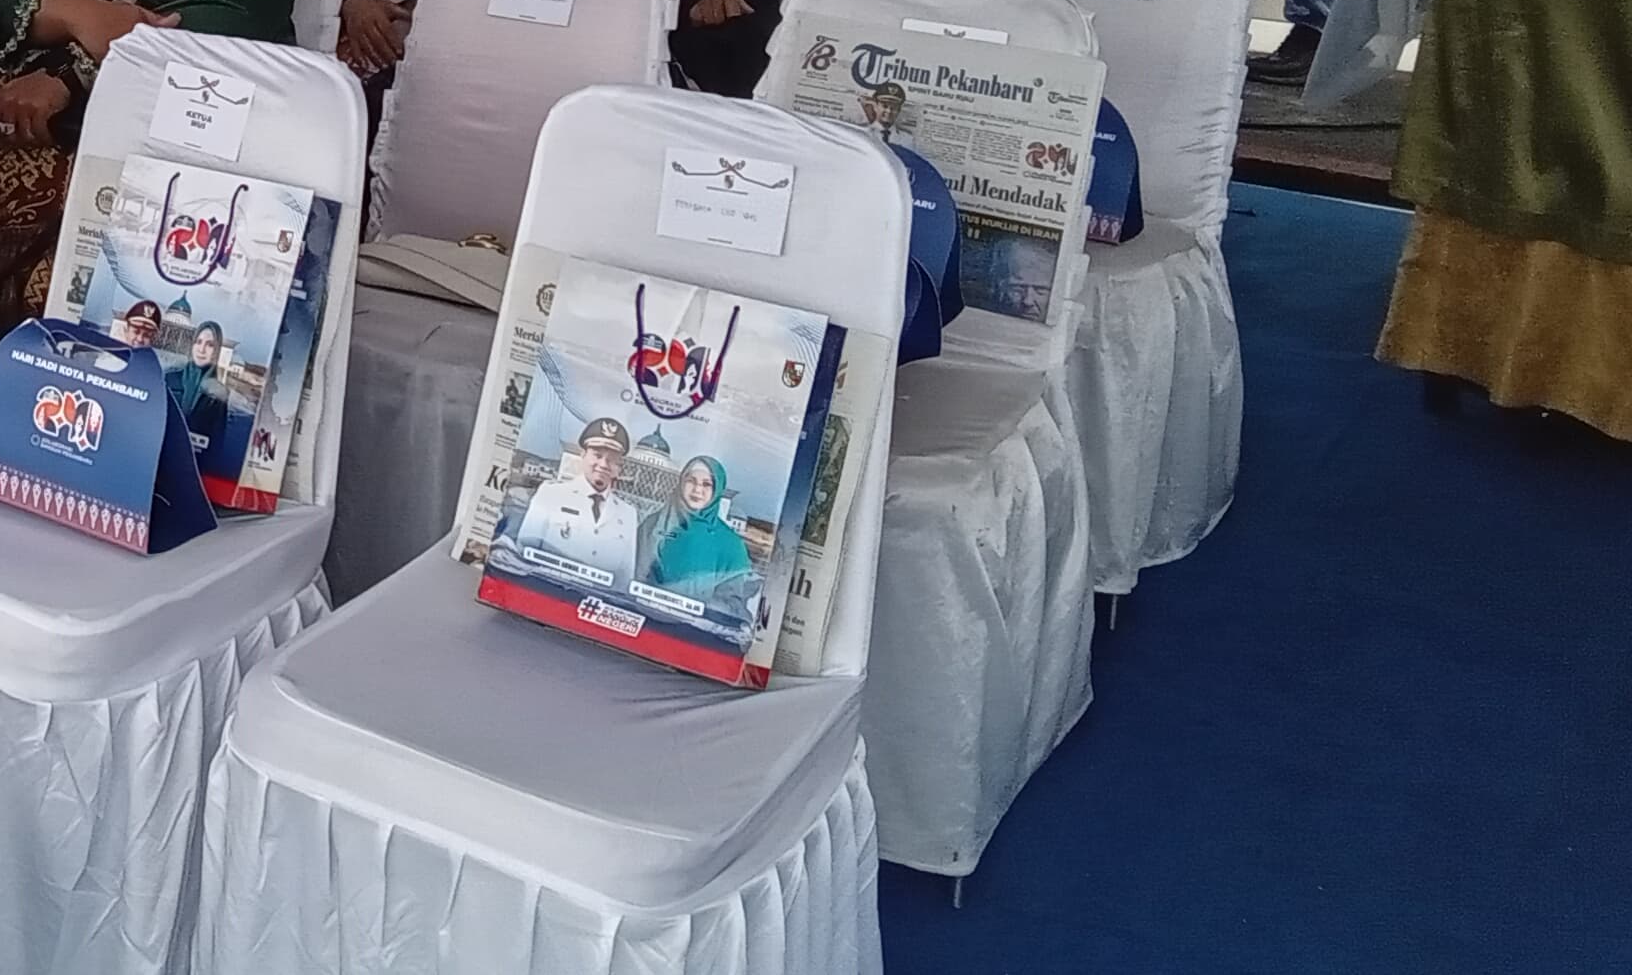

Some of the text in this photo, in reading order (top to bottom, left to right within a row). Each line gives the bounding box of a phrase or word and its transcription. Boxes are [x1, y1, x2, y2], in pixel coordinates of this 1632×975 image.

[850, 43, 1035, 104] Tribun Pekanbaru
[911, 198, 937, 210] ARU
[969, 177, 1067, 214] Mendadak
[1033, 228, 1060, 242] IRAN
[11, 350, 149, 402] HARI JADI KOTA PEKANBARU
